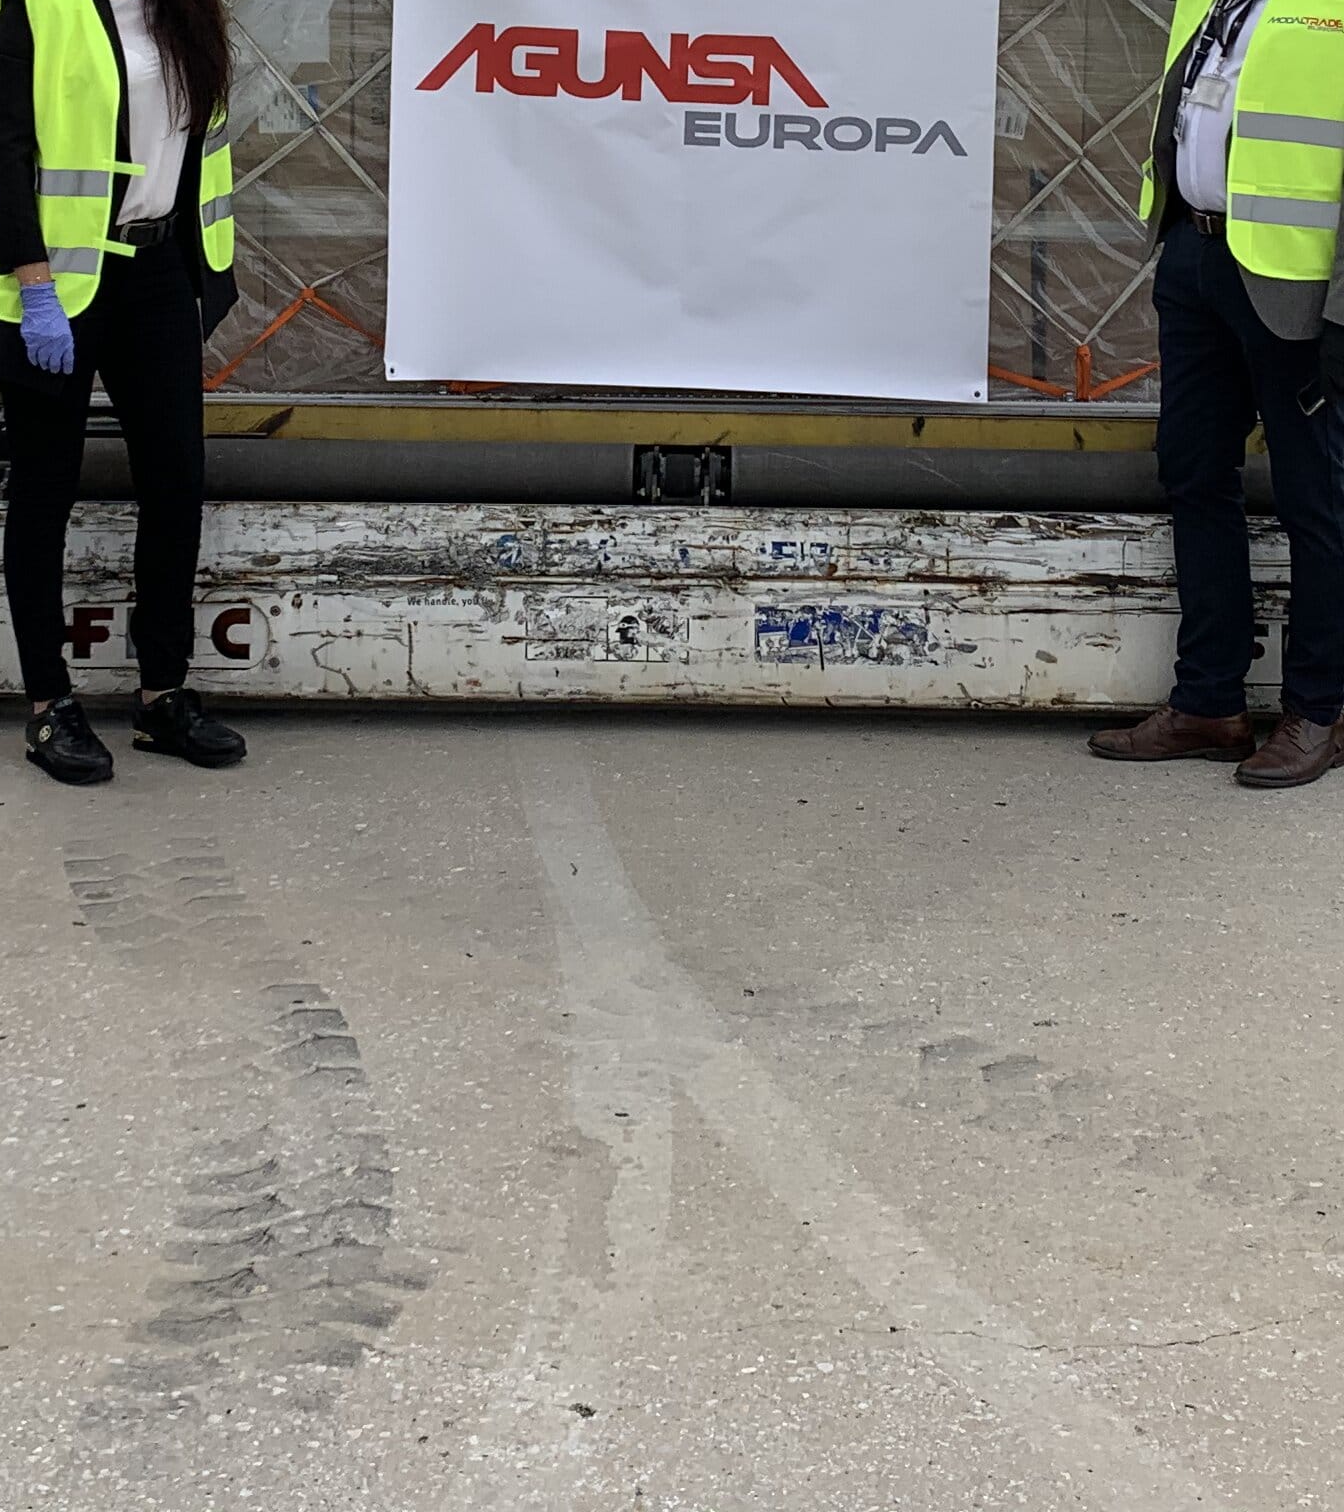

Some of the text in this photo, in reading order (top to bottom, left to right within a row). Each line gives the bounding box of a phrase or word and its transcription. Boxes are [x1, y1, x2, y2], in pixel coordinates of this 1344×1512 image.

[415, 23, 829, 109] AGUNSA
[683, 110, 968, 158] EUROPA
[407, 597, 422, 606] We
[65, 607, 251, 660] FC
